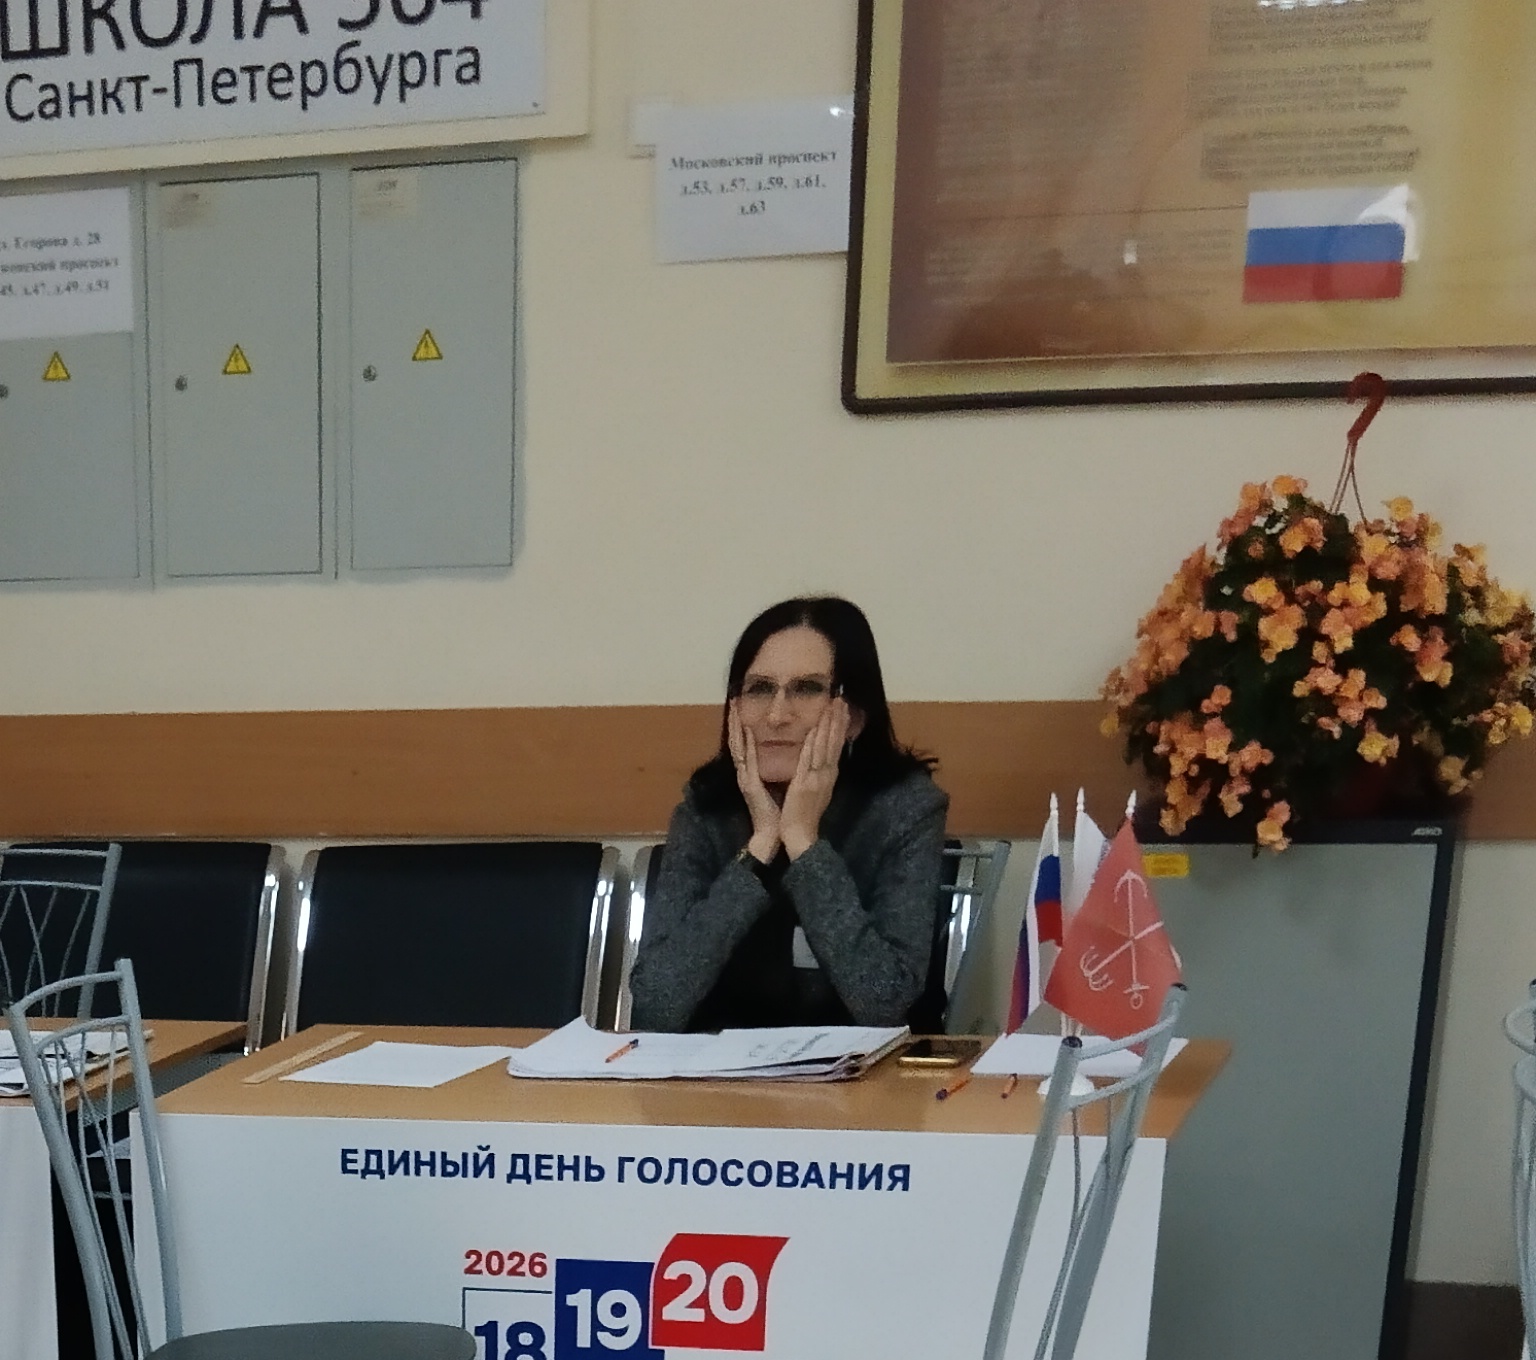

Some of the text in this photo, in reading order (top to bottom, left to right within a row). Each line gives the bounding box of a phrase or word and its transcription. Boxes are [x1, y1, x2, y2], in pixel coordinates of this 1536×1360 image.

[3, 39, 483, 123] Санкт-Петербурга
[669, 150, 837, 170] Московский проспект
[340, 1145, 911, 1193] ЕДИНЫЙ ДЕНЬ ГОЛОСОВАНИЯ
[463, 1249, 548, 1279] 2026
[565, 1288, 643, 1351] 19
[661, 1259, 759, 1325] 20
